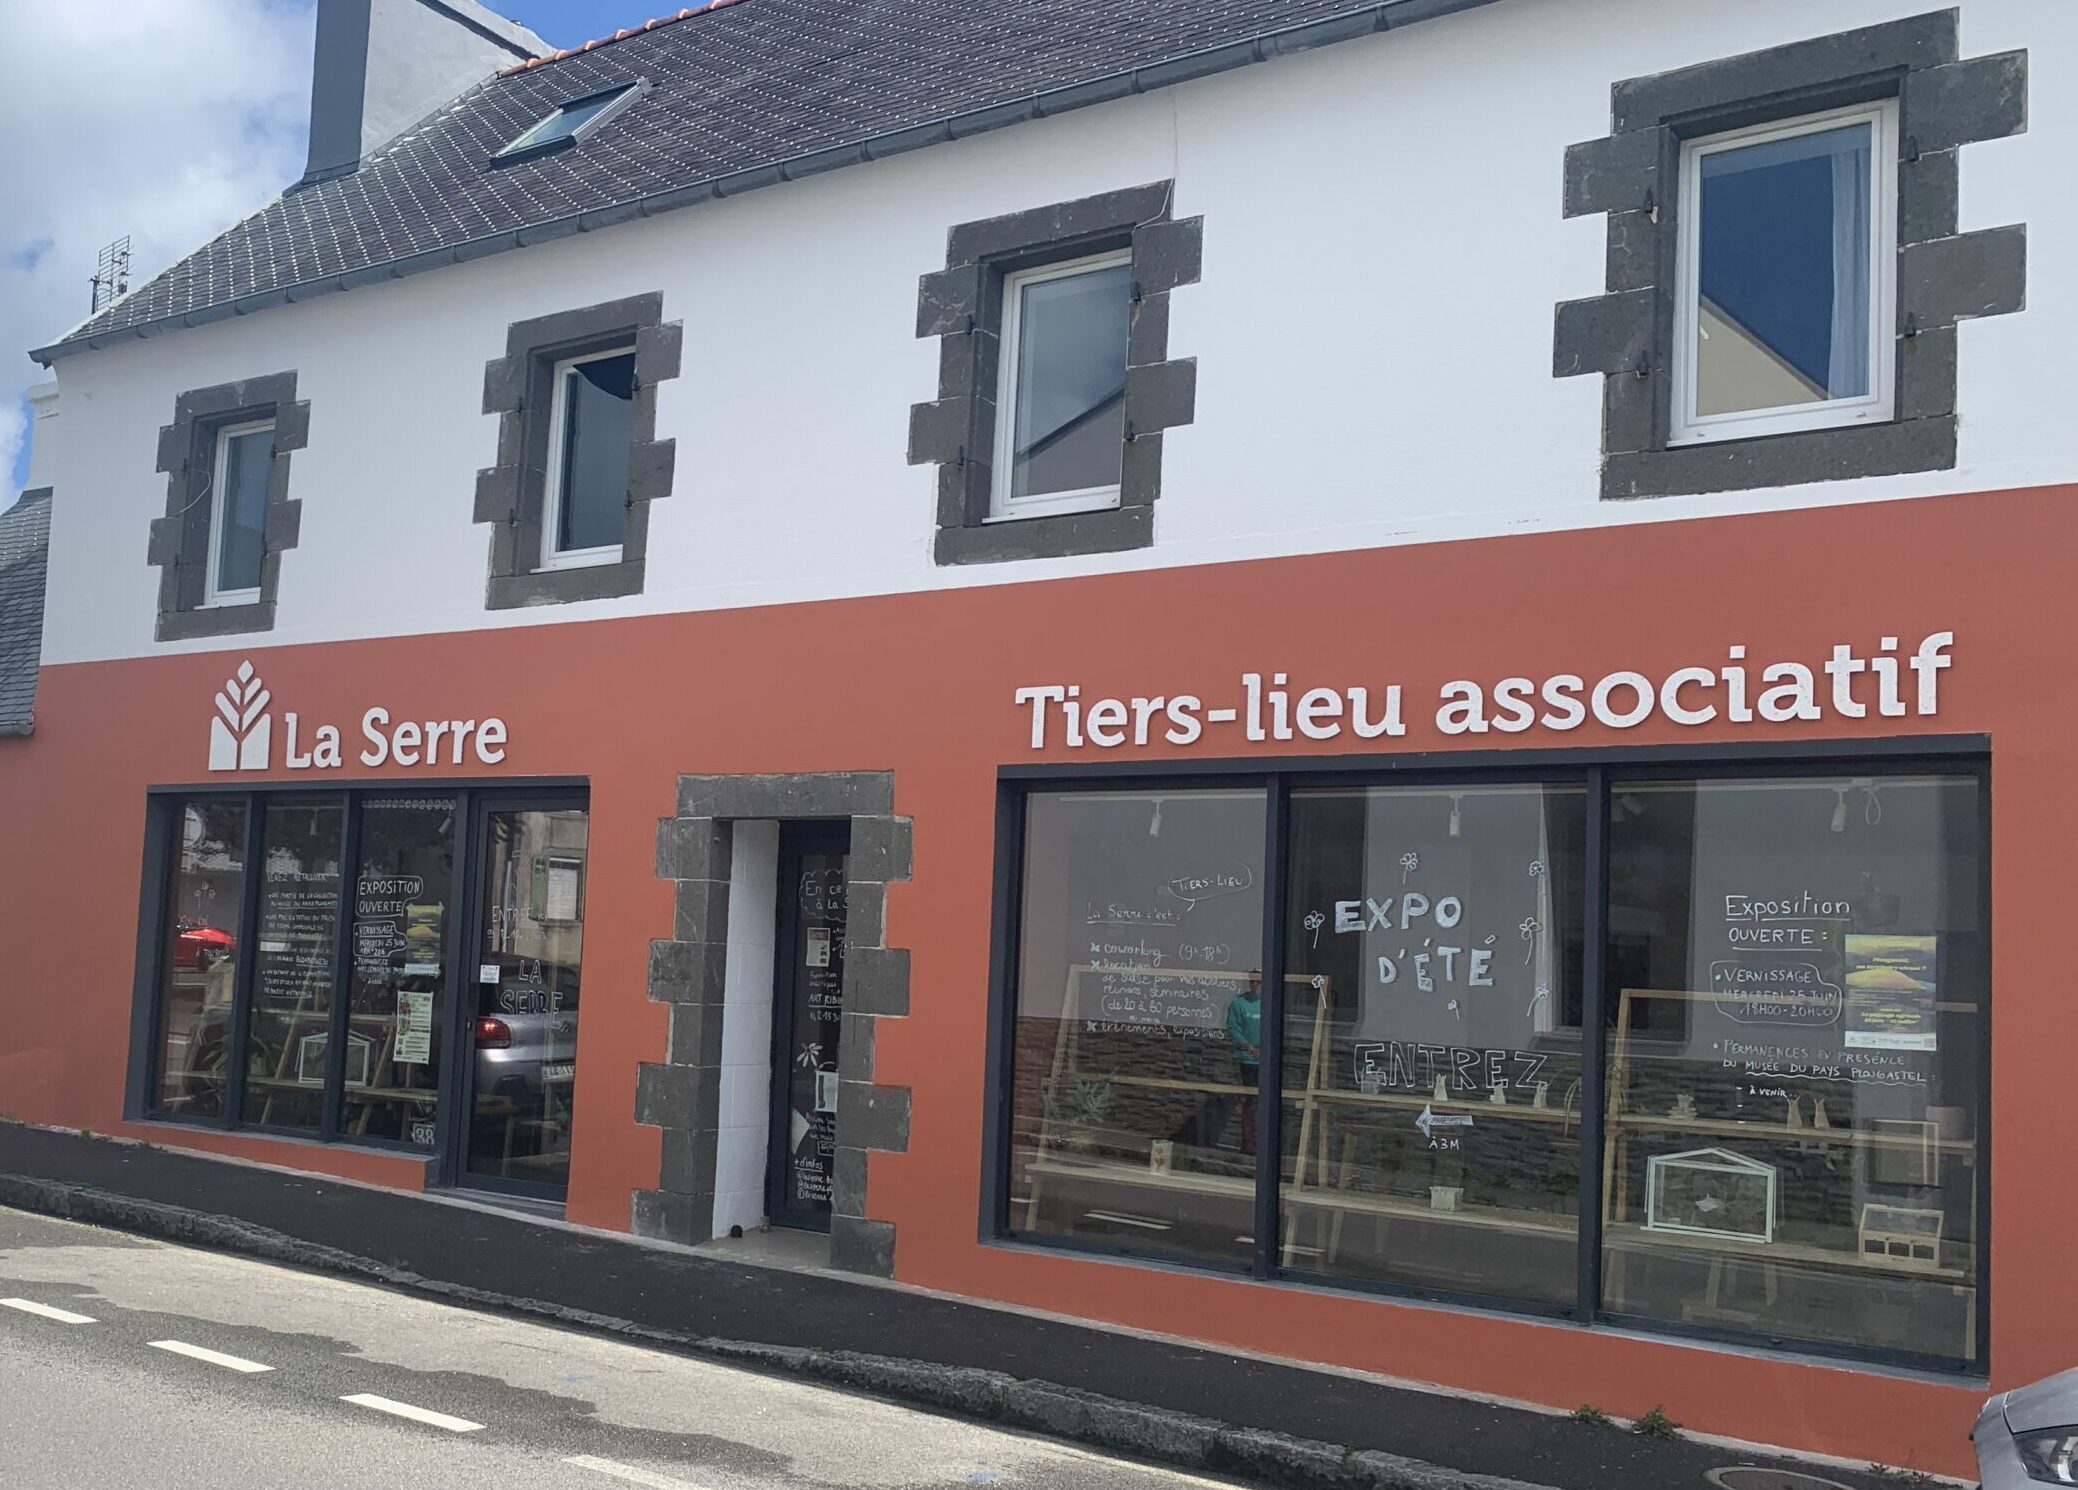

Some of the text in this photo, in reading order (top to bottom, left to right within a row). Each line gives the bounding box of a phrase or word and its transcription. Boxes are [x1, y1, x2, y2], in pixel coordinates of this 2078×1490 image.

[1014, 632, 1953, 749] Tiers-lieu associatif
[285, 706, 507, 768] La Serre
[806, 880, 822, 896] En
[830, 884, 842, 895] ce
[359, 901, 402, 913] OUVERTE
[1335, 892, 1462, 934] EXPO
[1725, 890, 1850, 922] Exposition
[1728, 927, 1815, 944] OUVERTE
[1103, 958, 1151, 973] location
[1104, 940, 1170, 967] coworking
[1378, 935, 1496, 992] D'ÉTÉ
[519, 959, 543, 984] LA
[1102, 974, 1116, 983] de
[500, 990, 563, 1032] SERRE
[1723, 1039, 1808, 1059] PERMANENCES
[1354, 1041, 1551, 1091] ENTREZ
[1723, 1059, 1737, 1068] DU
[1745, 1058, 1780, 1072] MUSÉE
[1790, 1064, 1806, 1073] DU
[1813, 1066, 1840, 1077] PAYS
[1851, 1068, 1927, 1082] PLOUGASTEL
[1750, 1084, 1756, 1095] À
[415, 1127, 435, 1145] 38
